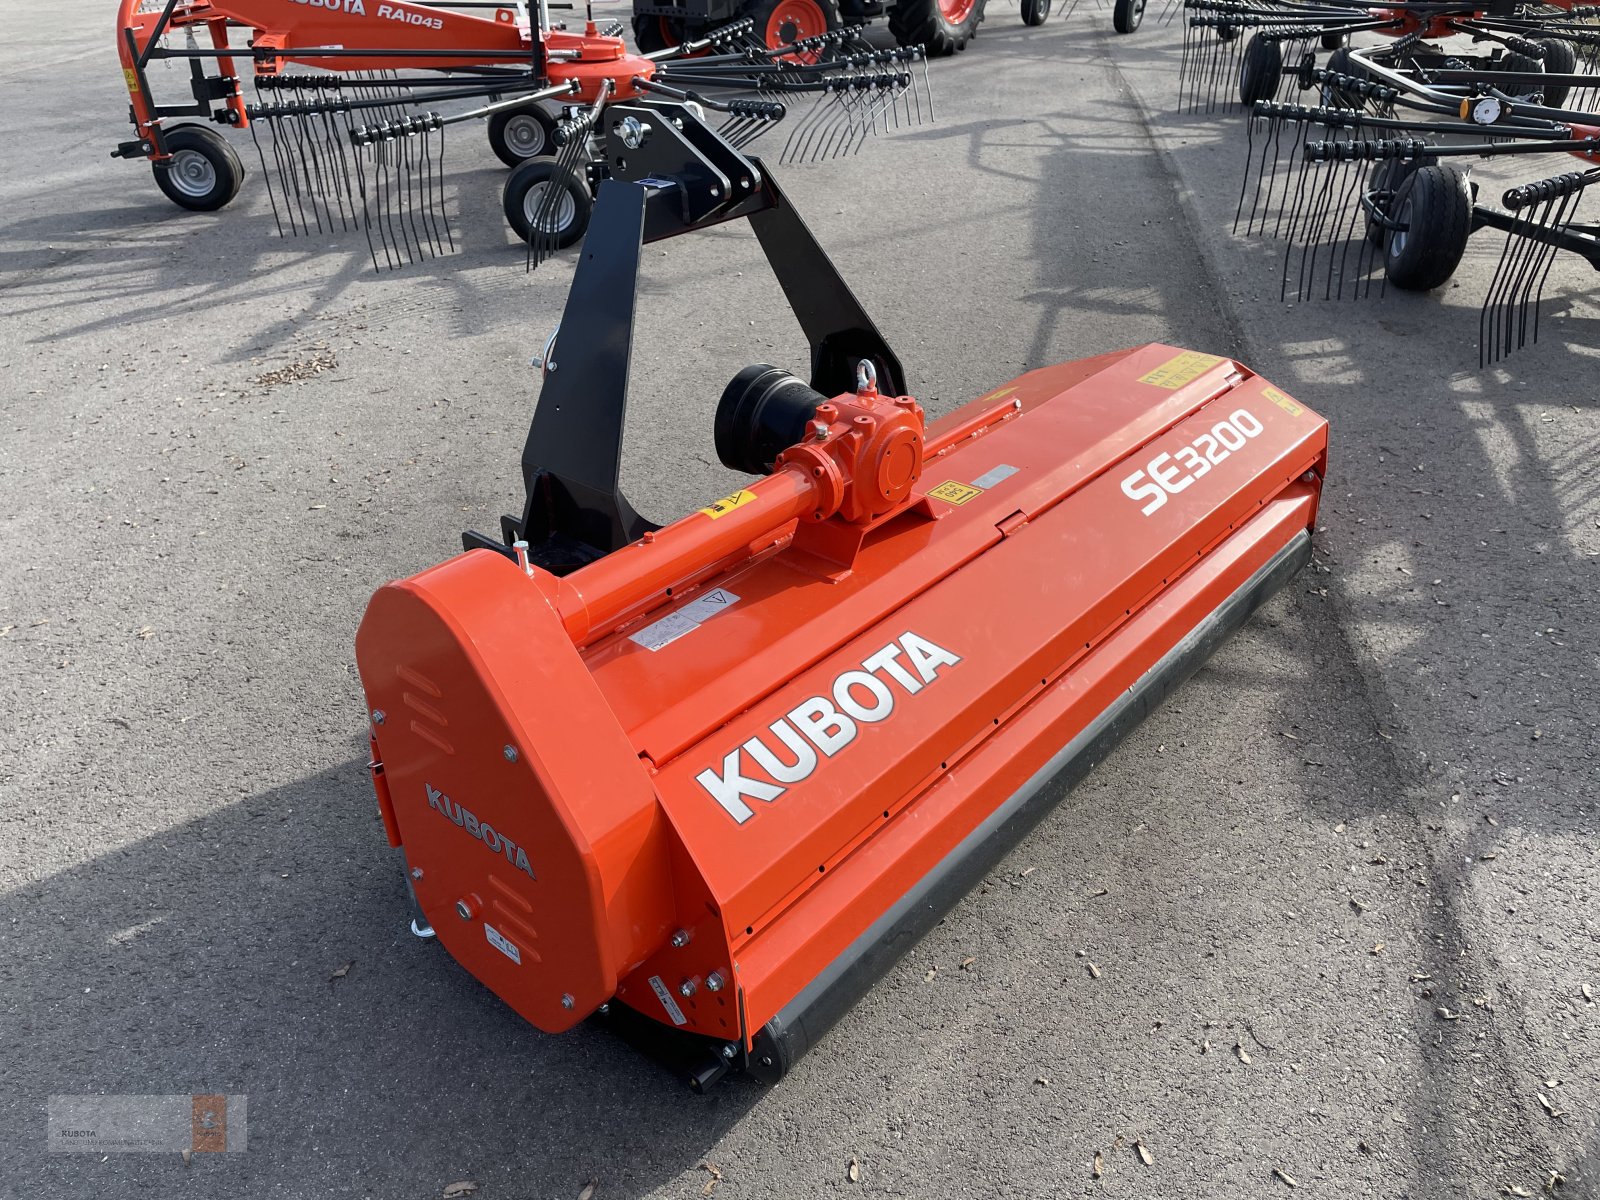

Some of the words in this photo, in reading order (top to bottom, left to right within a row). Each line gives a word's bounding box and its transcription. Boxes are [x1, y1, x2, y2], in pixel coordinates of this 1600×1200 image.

[377, 4, 443, 30] RA1043
[1120, 408, 1264, 517] SE3200
[695, 630, 964, 825] KUBOTA
[424, 782, 537, 882] KUBOTA
